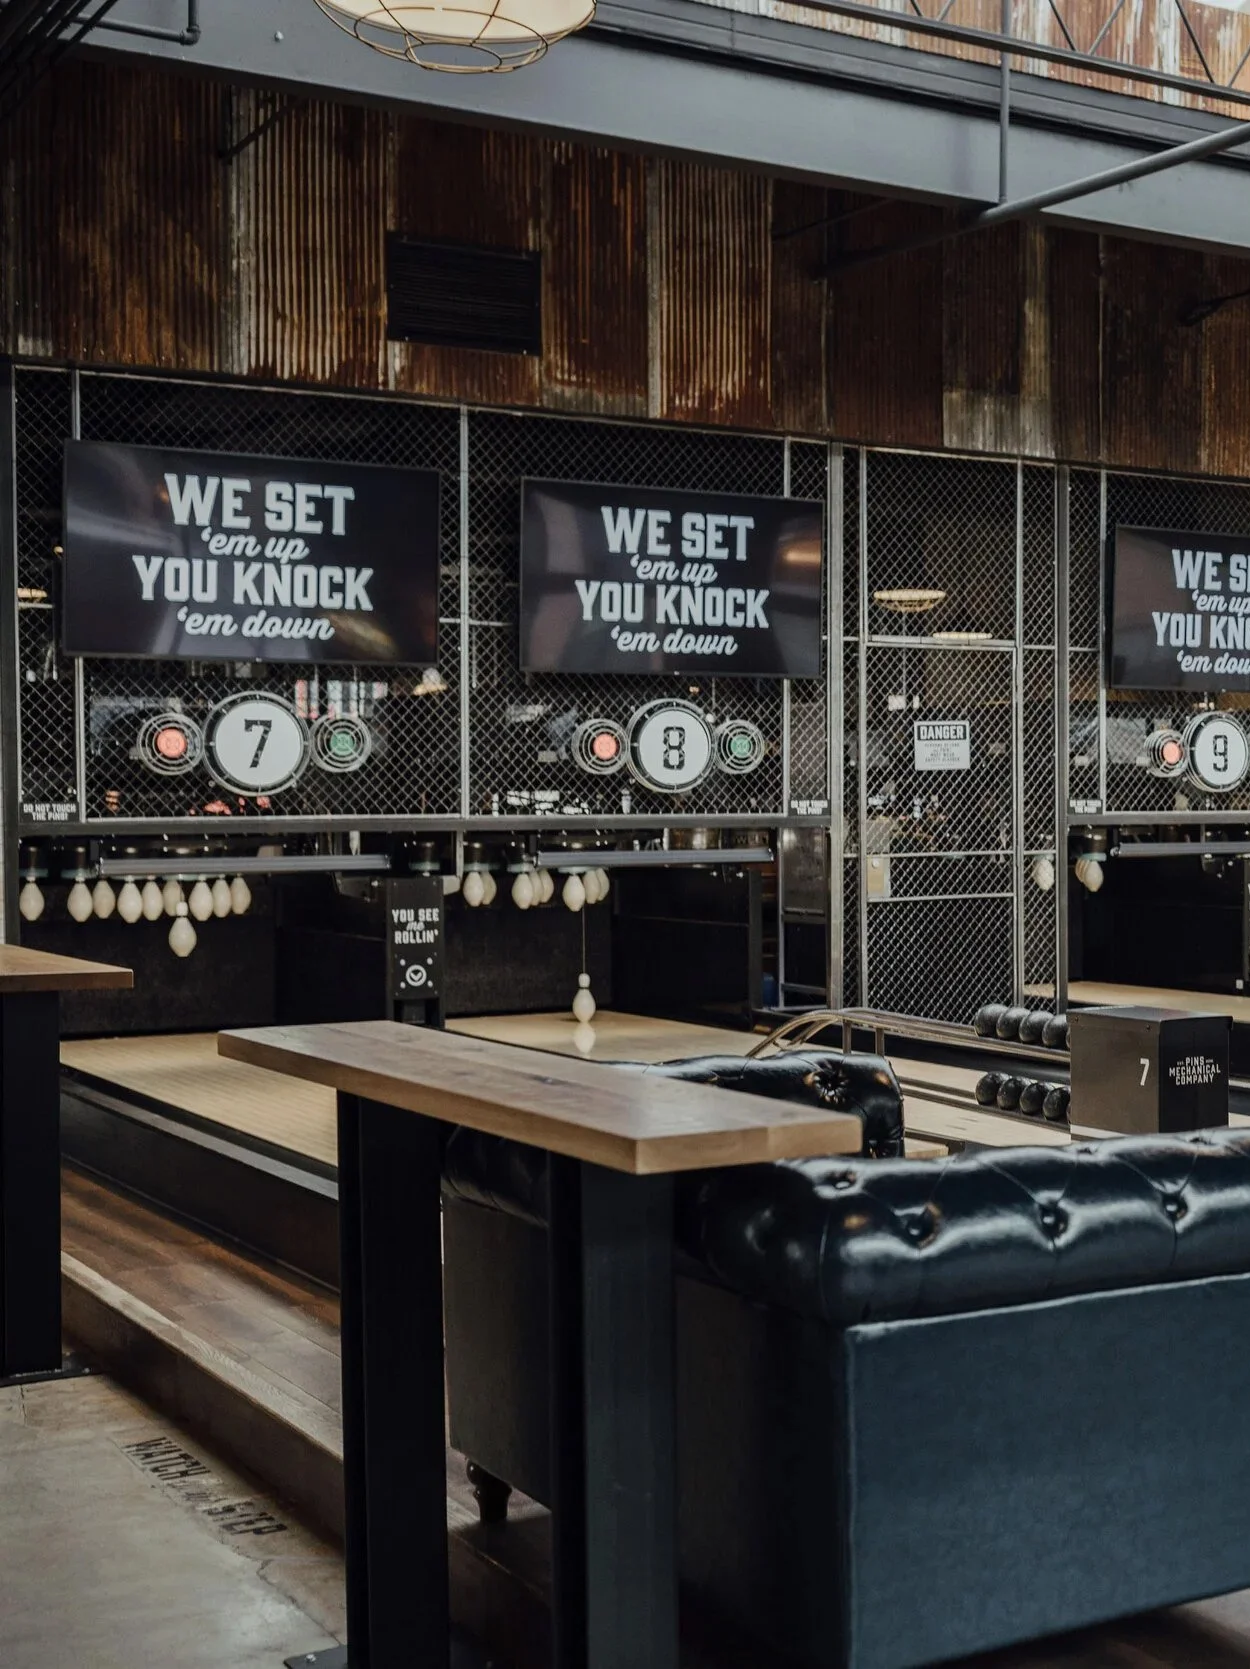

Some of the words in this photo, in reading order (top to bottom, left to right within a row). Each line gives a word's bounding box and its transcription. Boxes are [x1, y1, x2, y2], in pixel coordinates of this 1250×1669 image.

[164, 473, 251, 529] WE
[264, 480, 355, 536] SET
[201, 526, 262, 557] 'em
[264, 537, 309, 564] up
[601, 506, 672, 556] WE
[681, 512, 755, 561] SET
[132, 555, 218, 603] YOU
[233, 561, 373, 611] KNOCK
[630, 554, 679, 581] 'em
[681, 562, 718, 587] up
[1172, 549, 1223, 591] WE
[575, 580, 644, 623] YOU
[656, 584, 770, 628] KNOCK
[1191, 589, 1228, 612] 'em
[177, 606, 238, 636] 'em
[241, 610, 335, 641] down
[610, 625, 660, 652] 'em
[663, 628, 738, 655] down
[1152, 611, 1202, 648] YOU
[1176, 650, 1212, 673] 'em
[244, 719, 272, 768] 7
[663, 726, 686, 770] 8
[920, 725, 964, 740] DANGER
[1213, 734, 1228, 772] 9
[35, 803, 50, 813] NOT
[51, 803, 76, 813] TOUCH
[392, 908, 415, 923] YOU
[418, 907, 440, 922] SEE
[1140, 1058, 1150, 1086] 7
[1169, 1063, 1221, 1077] MECHANICAL
[1185, 1056, 1205, 1066] PINS
[1175, 1073, 1214, 1086] COMPANY
[121, 1437, 211, 1481] WATCH
